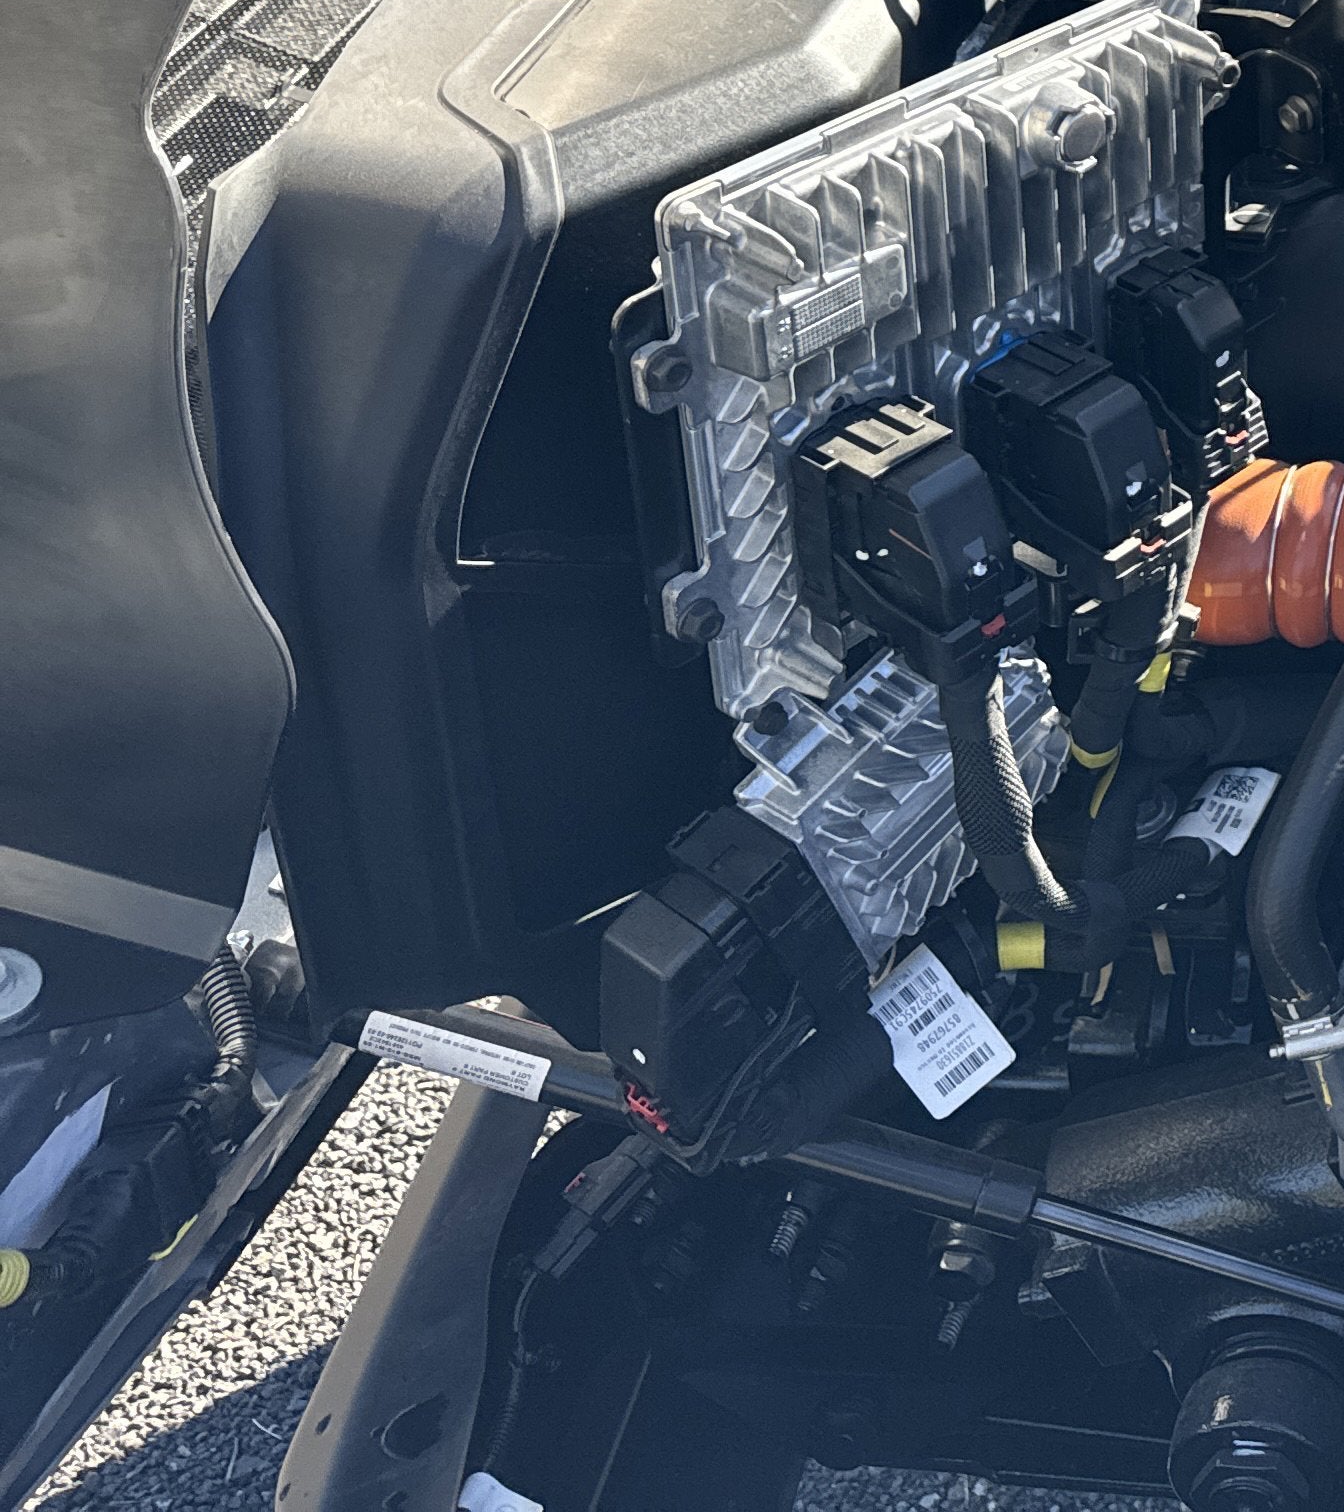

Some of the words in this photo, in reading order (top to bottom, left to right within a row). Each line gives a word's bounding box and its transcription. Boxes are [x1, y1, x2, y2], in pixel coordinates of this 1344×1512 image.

[888, 983, 943, 1031] 7509745C91
[915, 1012, 962, 1053] 85767948
[934, 1034, 975, 1071] Z18851630
